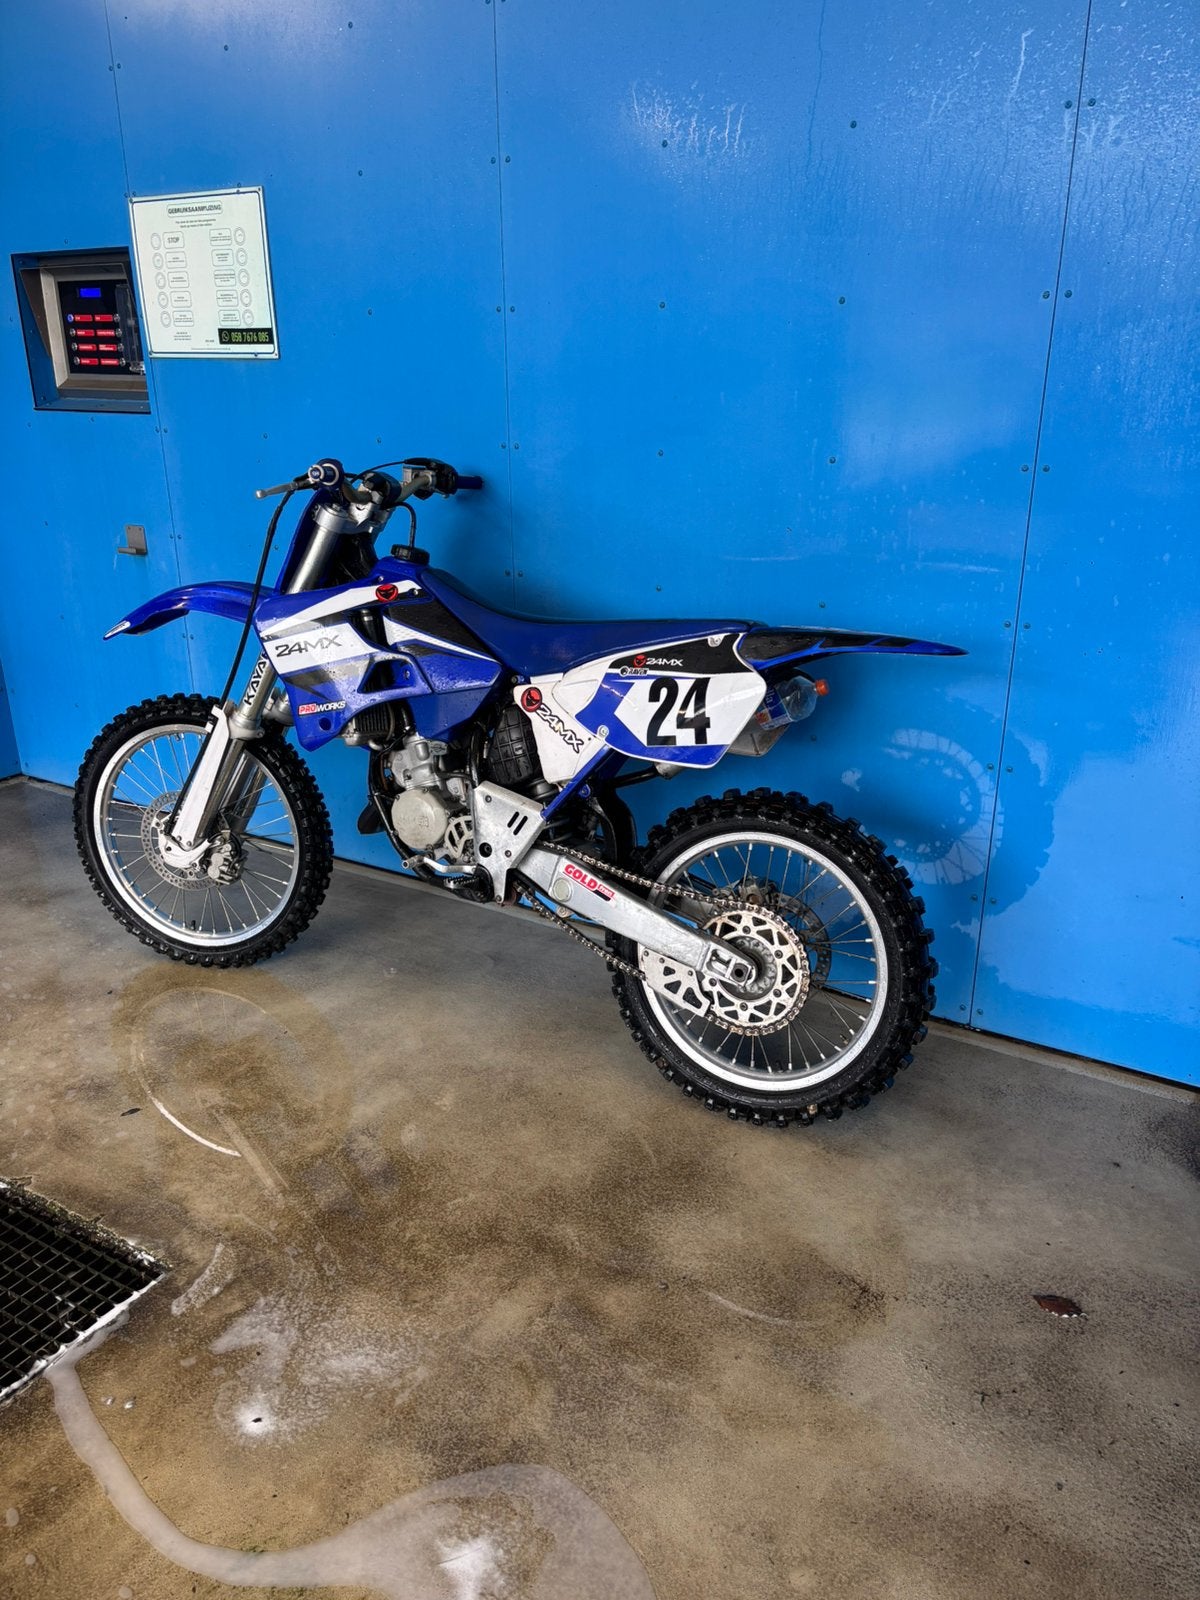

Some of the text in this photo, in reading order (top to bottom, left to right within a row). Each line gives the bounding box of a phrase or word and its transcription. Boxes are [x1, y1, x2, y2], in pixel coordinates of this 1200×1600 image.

[167, 236, 180, 244] STOP
[242, 332, 257, 342] 7676
[275, 635, 342, 658] 24MX
[645, 657, 684, 667] 24MX
[628, 667, 648, 676] RAVEN
[646, 677, 711, 747] 24
[535, 702, 584, 754] 24MX
[564, 864, 598, 890] GOLD
